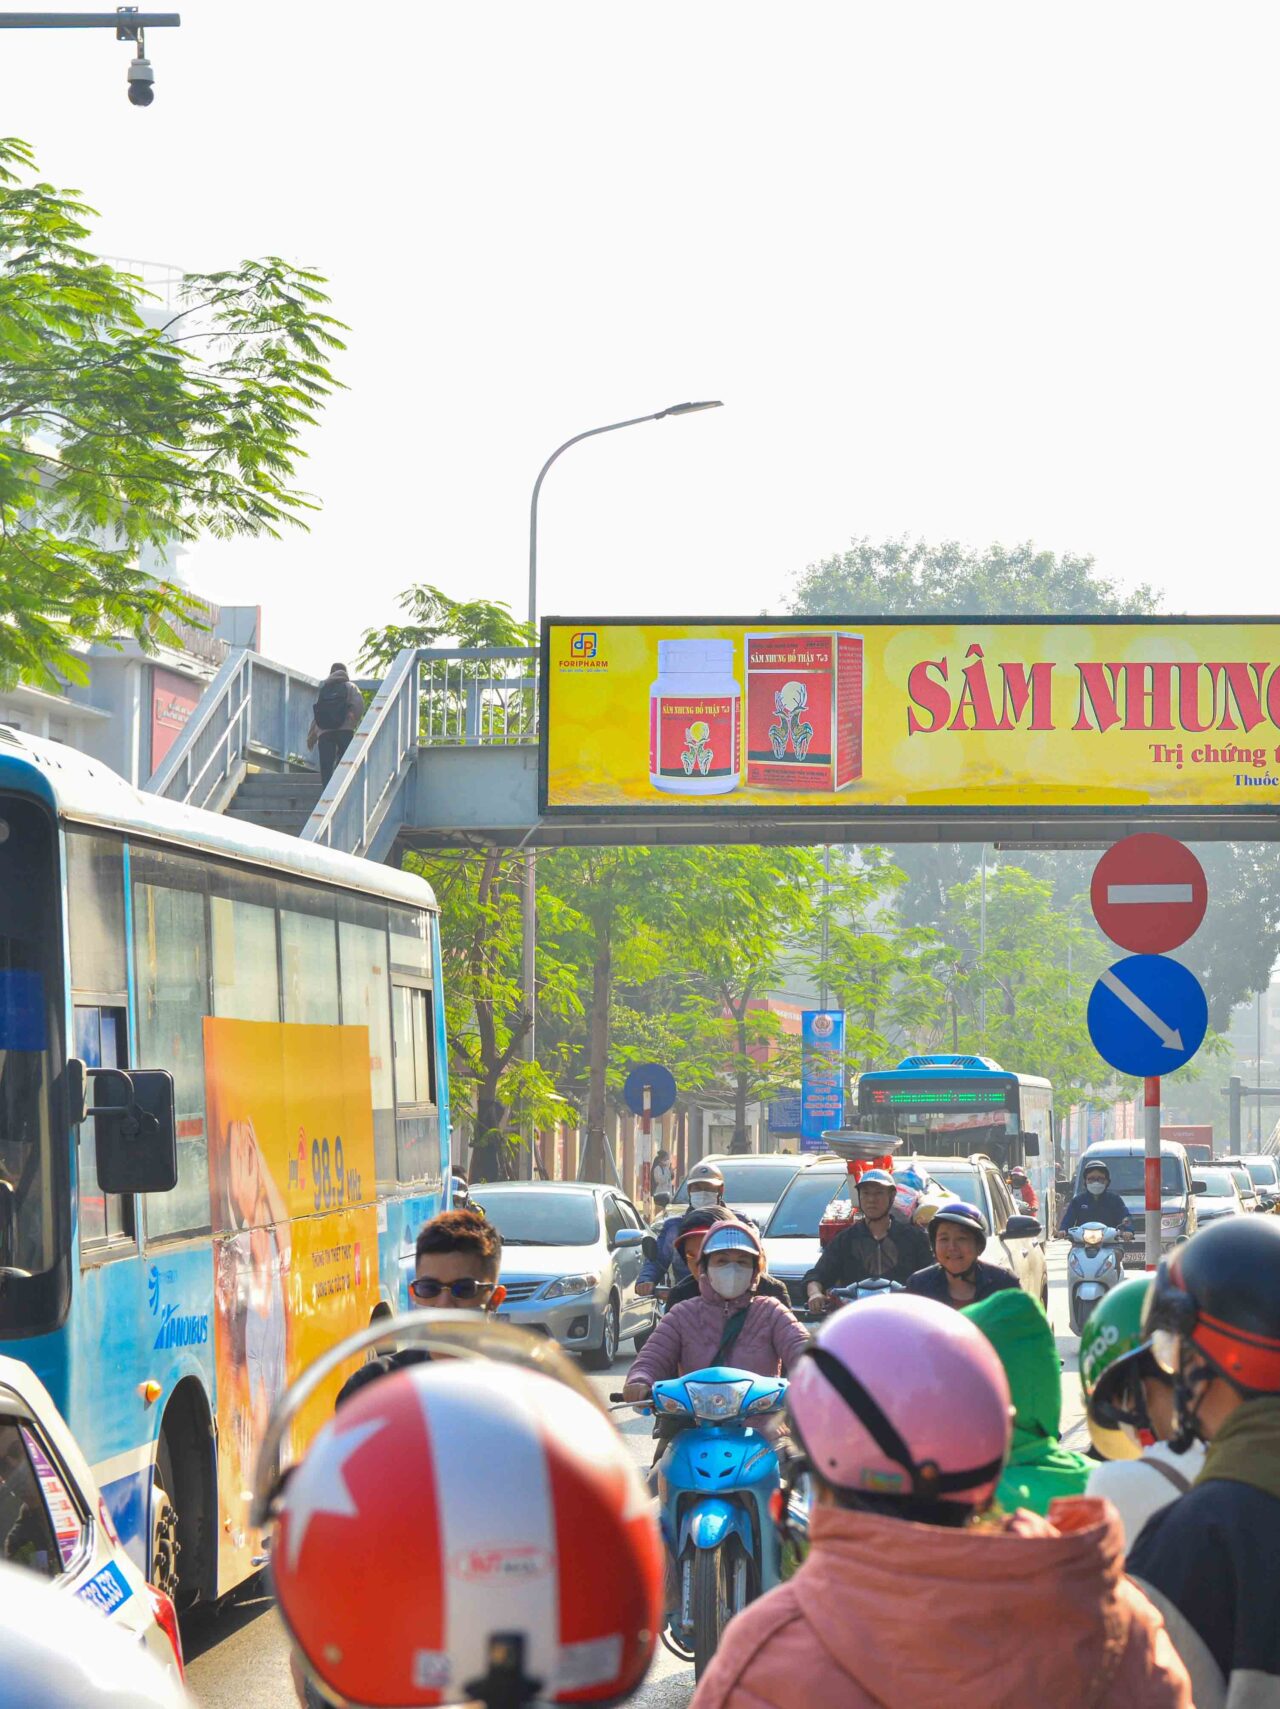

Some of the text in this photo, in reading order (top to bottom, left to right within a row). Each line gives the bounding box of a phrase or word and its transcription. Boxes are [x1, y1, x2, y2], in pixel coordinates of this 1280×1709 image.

[559, 660, 608, 668] FORIPHARM
[907, 643, 1056, 736] SÂM
[1149, 743, 1184, 770] Trị
[1191, 742, 1266, 768] chứng
[1233, 771, 1280, 786] Thuốc
[312, 1135, 344, 1211] 98.9
